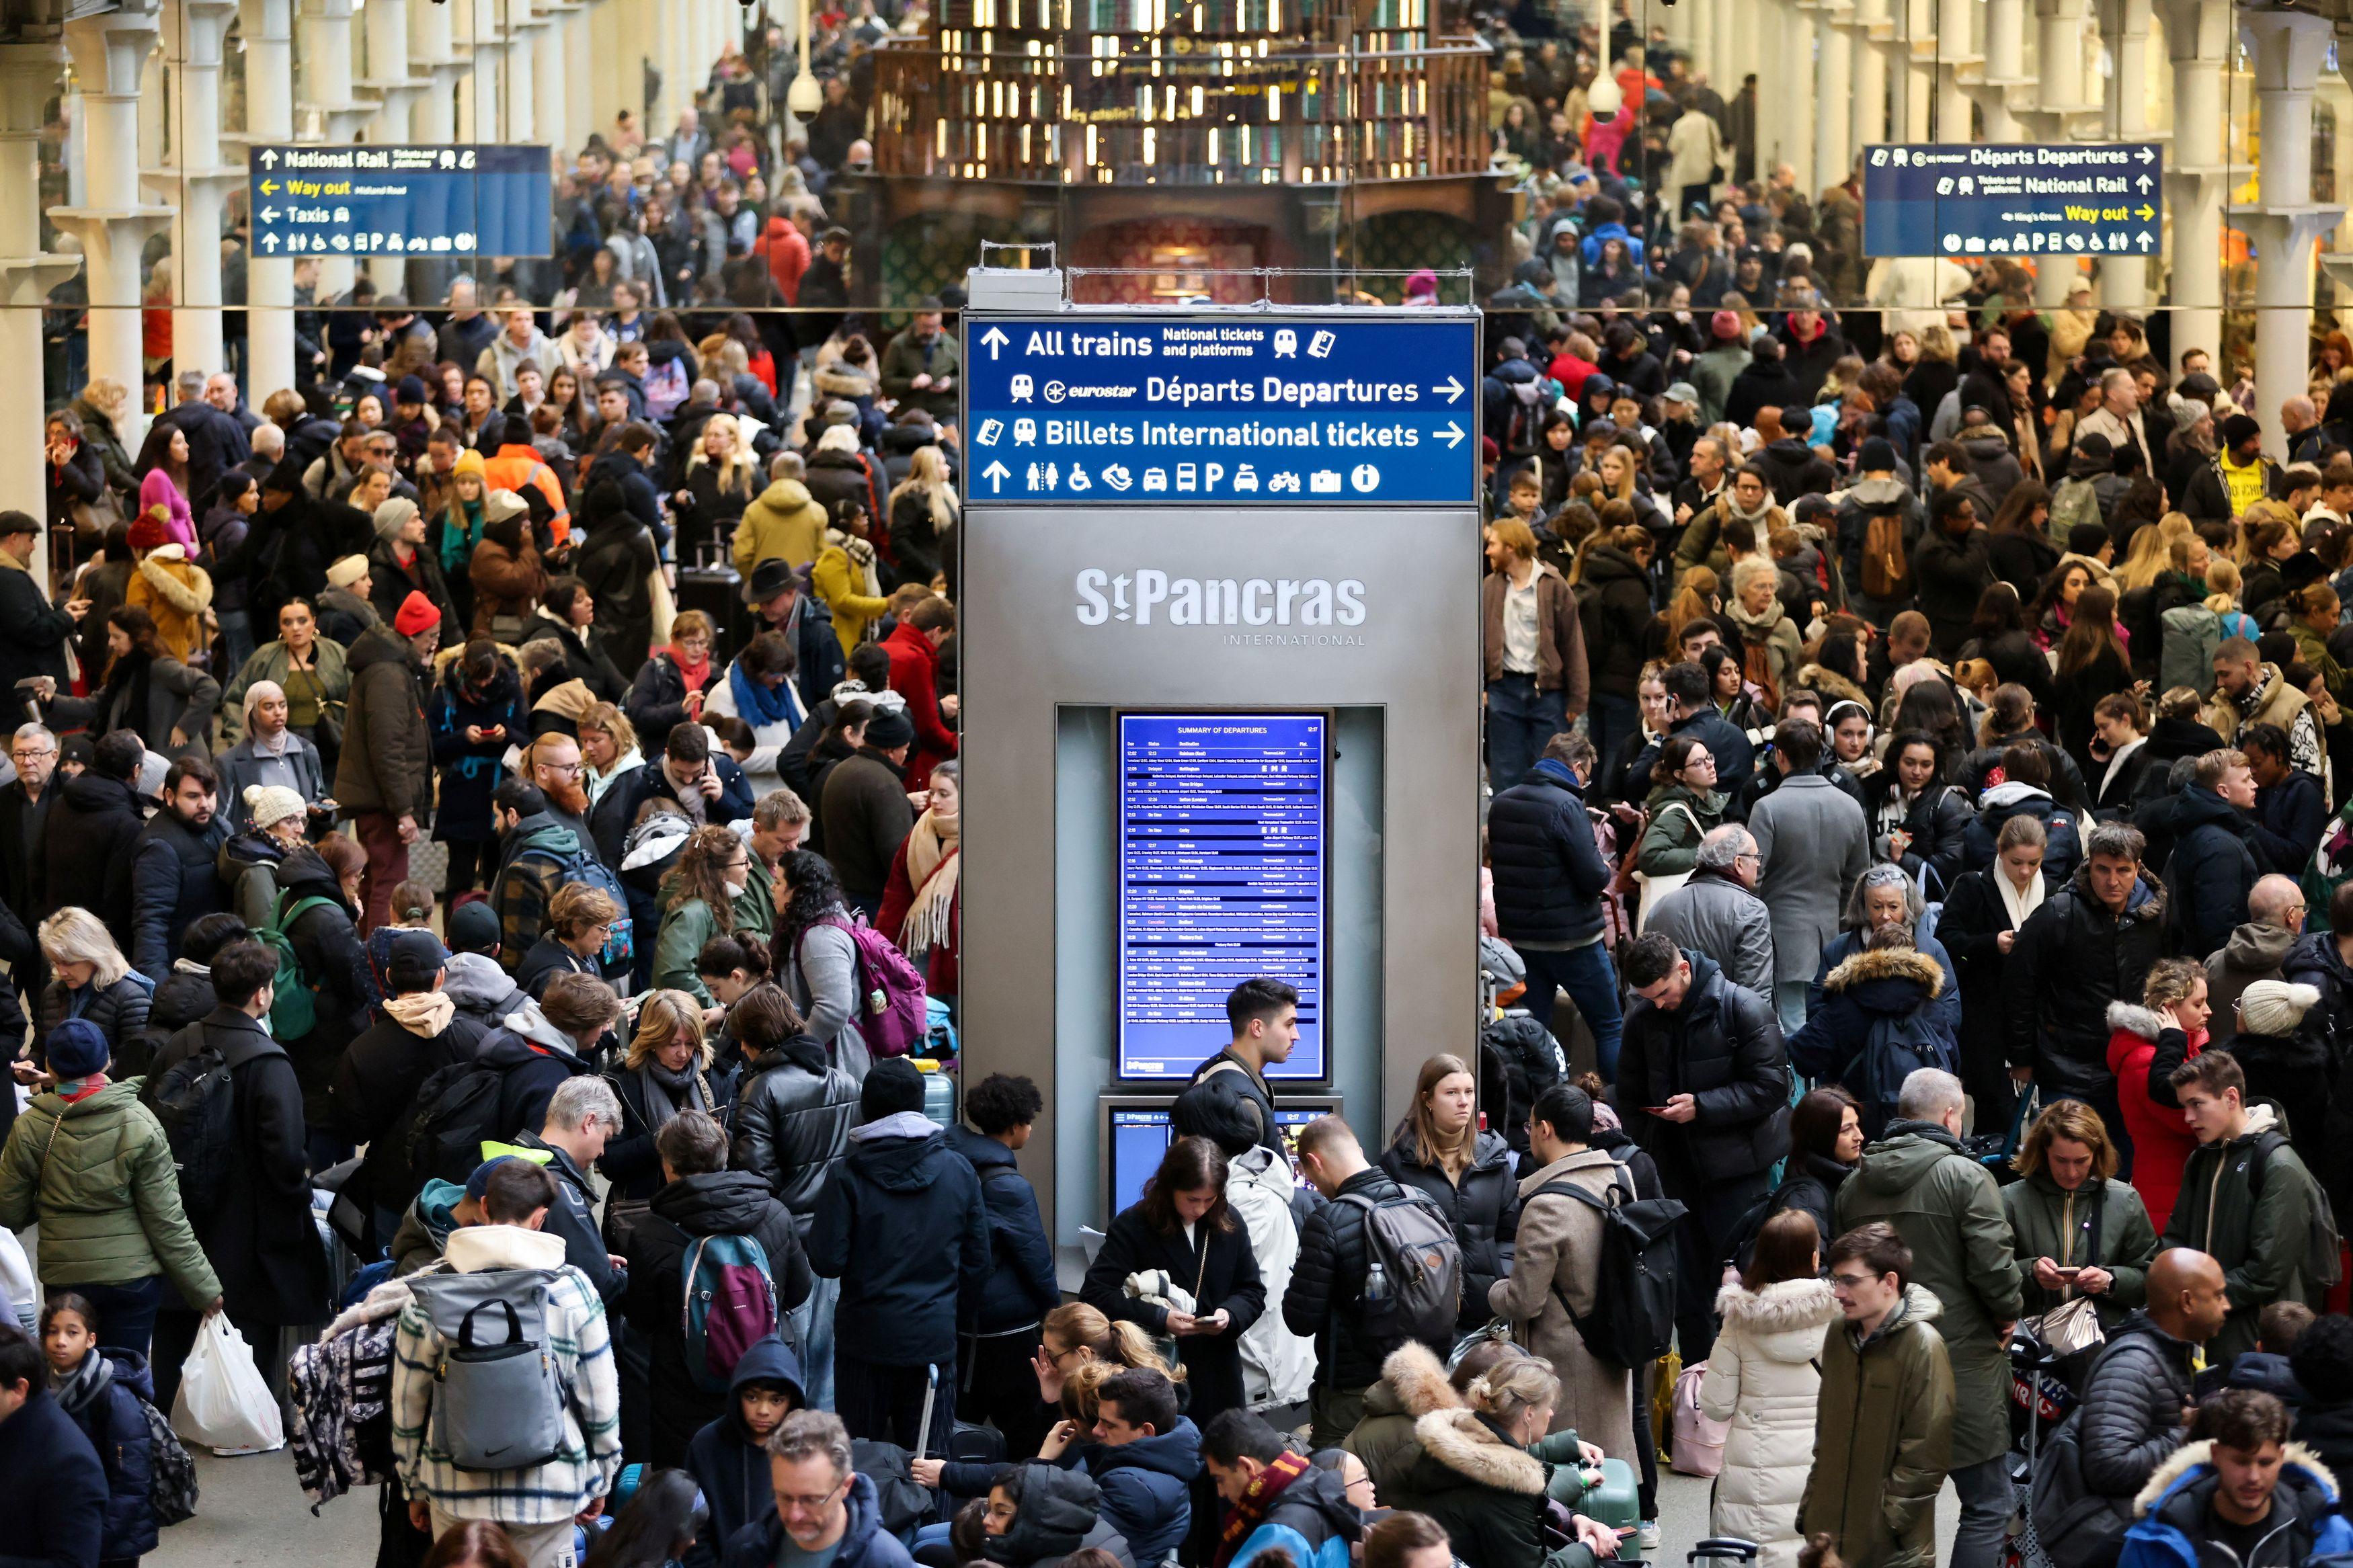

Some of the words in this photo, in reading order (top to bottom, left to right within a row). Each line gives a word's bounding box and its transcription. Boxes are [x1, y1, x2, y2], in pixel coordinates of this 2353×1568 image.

[285, 151, 354, 168] National
[356, 151, 390, 168] Rail
[420, 149, 437, 159] and
[1970, 149, 2034, 168] Départs
[2037, 149, 2128, 168] Departures
[2005, 176, 2021, 184] and
[2026, 177, 2092, 193] National
[2096, 177, 2127, 193] Rail
[287, 180, 321, 198] Way
[324, 181, 350, 195] out
[287, 207, 330, 222] Taxis
[2039, 213, 2063, 221] Cross
[2065, 206, 2099, 224] Way
[2102, 206, 2128, 220] out
[1163, 328, 1217, 341] National
[1220, 328, 1264, 341] tickets
[1026, 331, 1066, 356] All
[1074, 331, 1153, 356] trains
[1163, 343, 1187, 356] and
[1190, 343, 1253, 359] platforms
[1069, 385, 1137, 398] eurostar
[1147, 375, 1254, 408] Départs
[1263, 377, 1419, 408] Departures
[1046, 420, 1134, 445] Billets
[1143, 421, 1320, 447] International
[1327, 421, 1419, 447] tickets
[1223, 635, 1366, 647] INTERNATIONAL
